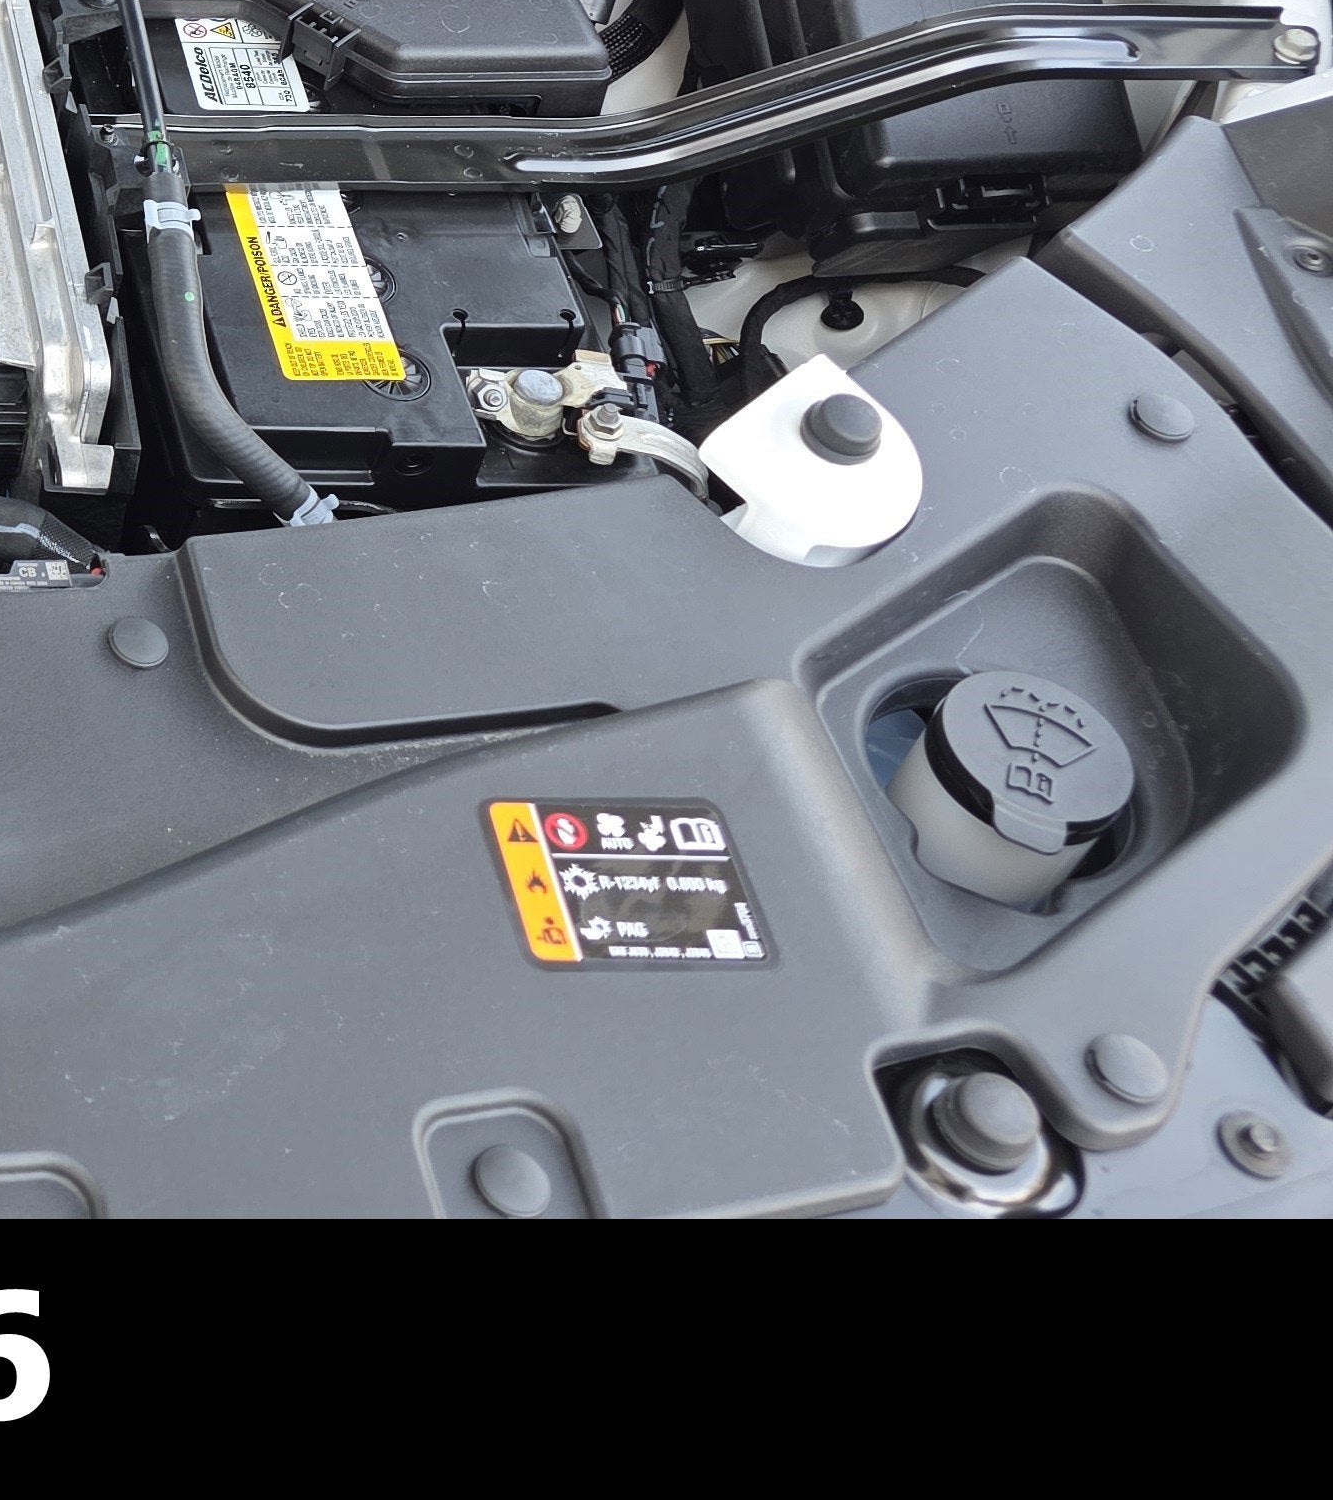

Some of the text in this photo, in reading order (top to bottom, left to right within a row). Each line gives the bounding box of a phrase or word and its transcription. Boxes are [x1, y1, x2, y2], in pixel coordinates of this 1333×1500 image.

[193, 47, 219, 102] ACDelco
[240, 64, 257, 89] 8540
[246, 235, 282, 317] DANGER/POISON
[18, 566, 37, 578] CB
[601, 836, 635, 850] AUTO
